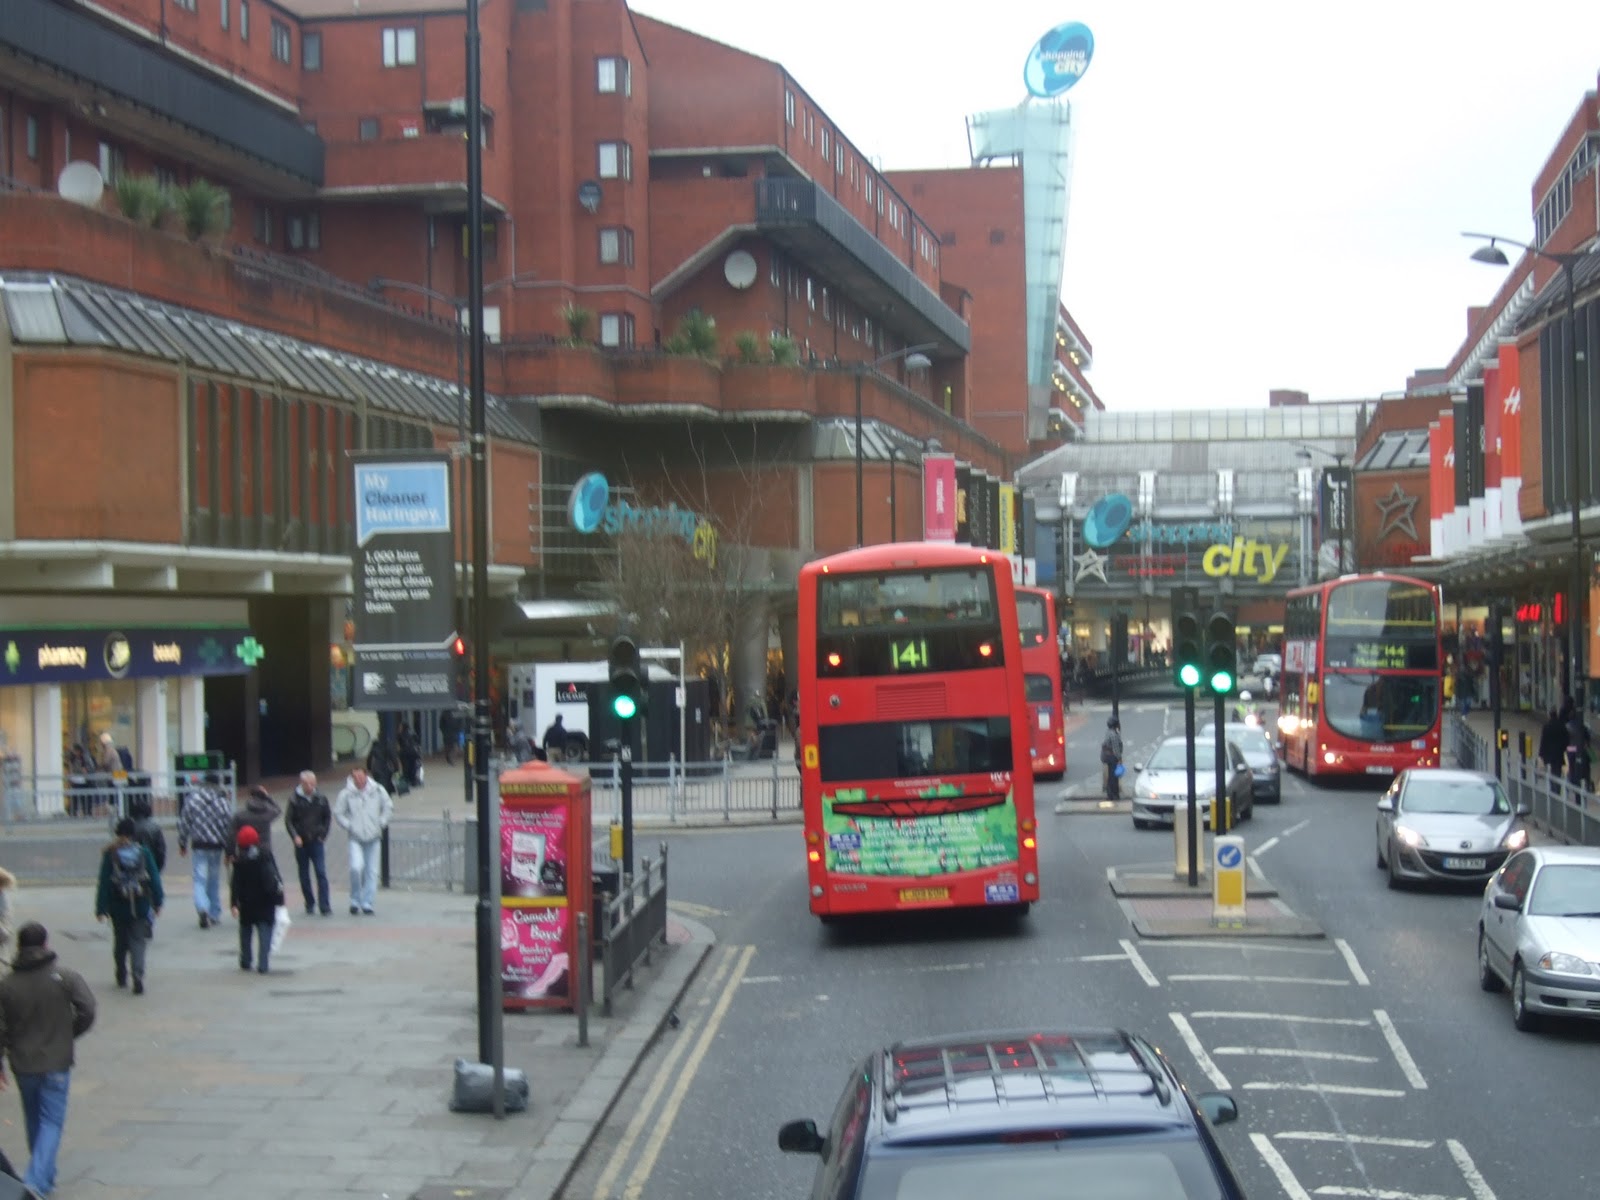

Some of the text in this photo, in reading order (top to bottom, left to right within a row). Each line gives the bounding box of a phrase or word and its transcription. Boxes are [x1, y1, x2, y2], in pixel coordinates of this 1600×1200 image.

[365, 472, 388, 491] My
[365, 490, 426, 507] Cleaner
[1202, 535, 1289, 583] city
[364, 563, 424, 577] to keep our
[365, 575, 433, 588] streets clean
[372, 588, 409, 601] Please
[410, 588, 431, 600] use
[38, 643, 88, 670] pharmacy
[891, 640, 928, 669] 141
[512, 907, 560, 926] Comedy!
[530, 924, 563, 945] Boys!
